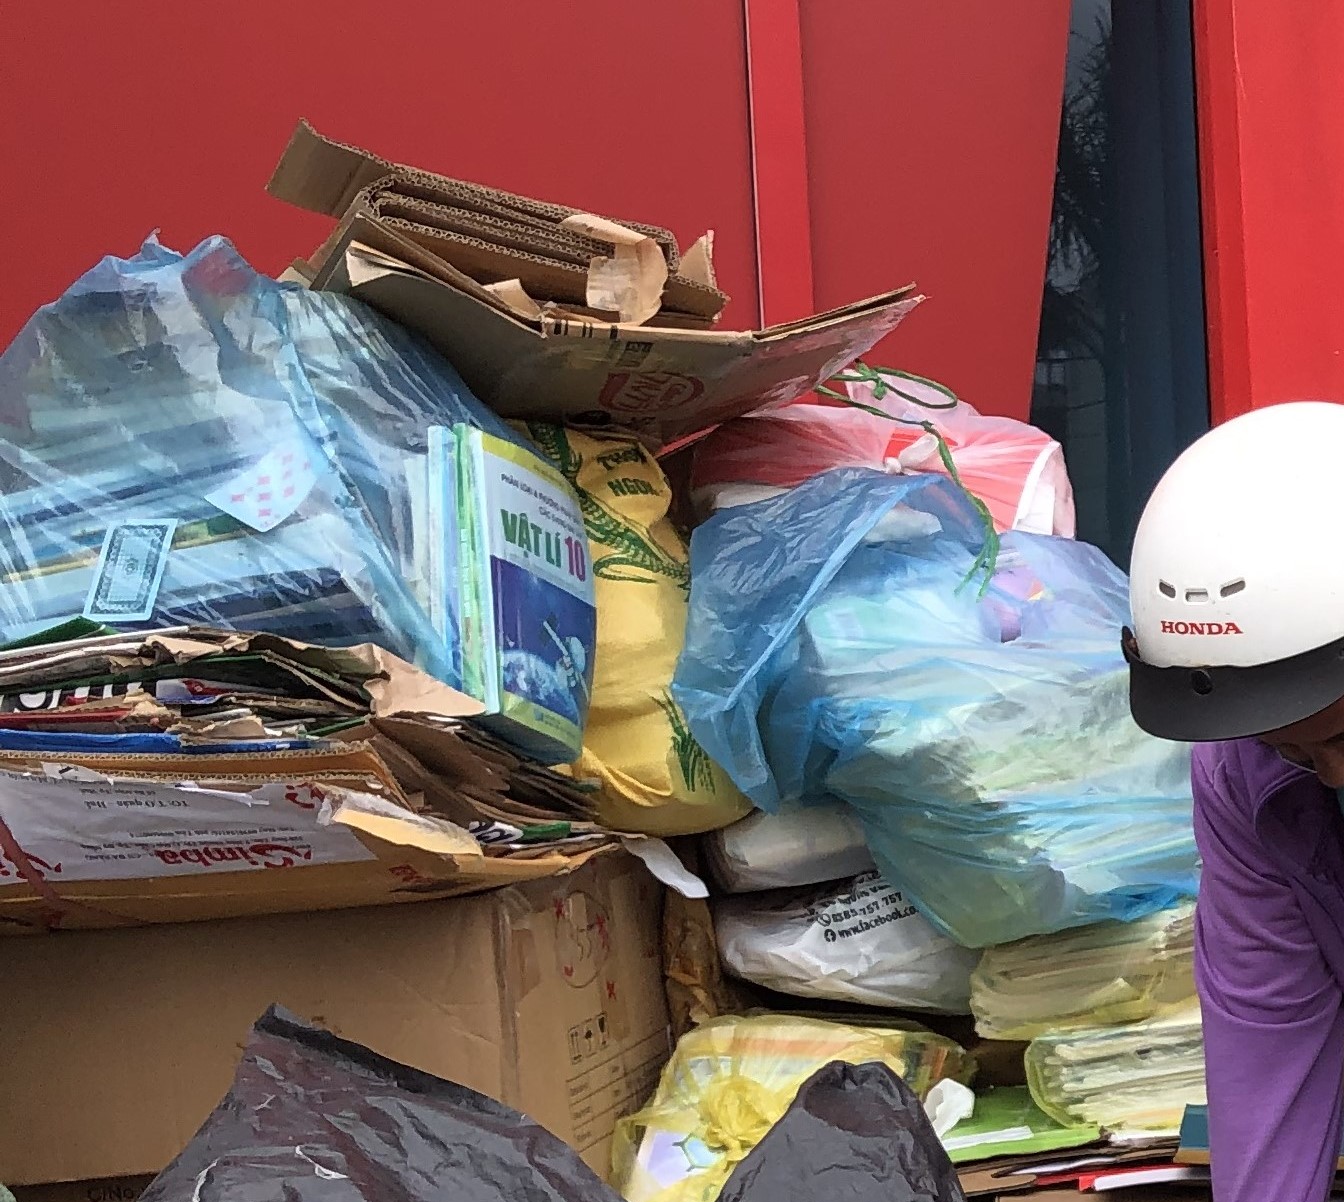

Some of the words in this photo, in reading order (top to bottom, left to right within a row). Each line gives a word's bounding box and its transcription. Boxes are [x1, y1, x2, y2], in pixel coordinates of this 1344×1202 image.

[500, 508, 543, 560] VẬT
[565, 535, 586, 583] 10
[1160, 620, 1244, 635] HONDA
[156, 843, 313, 868] Simba
